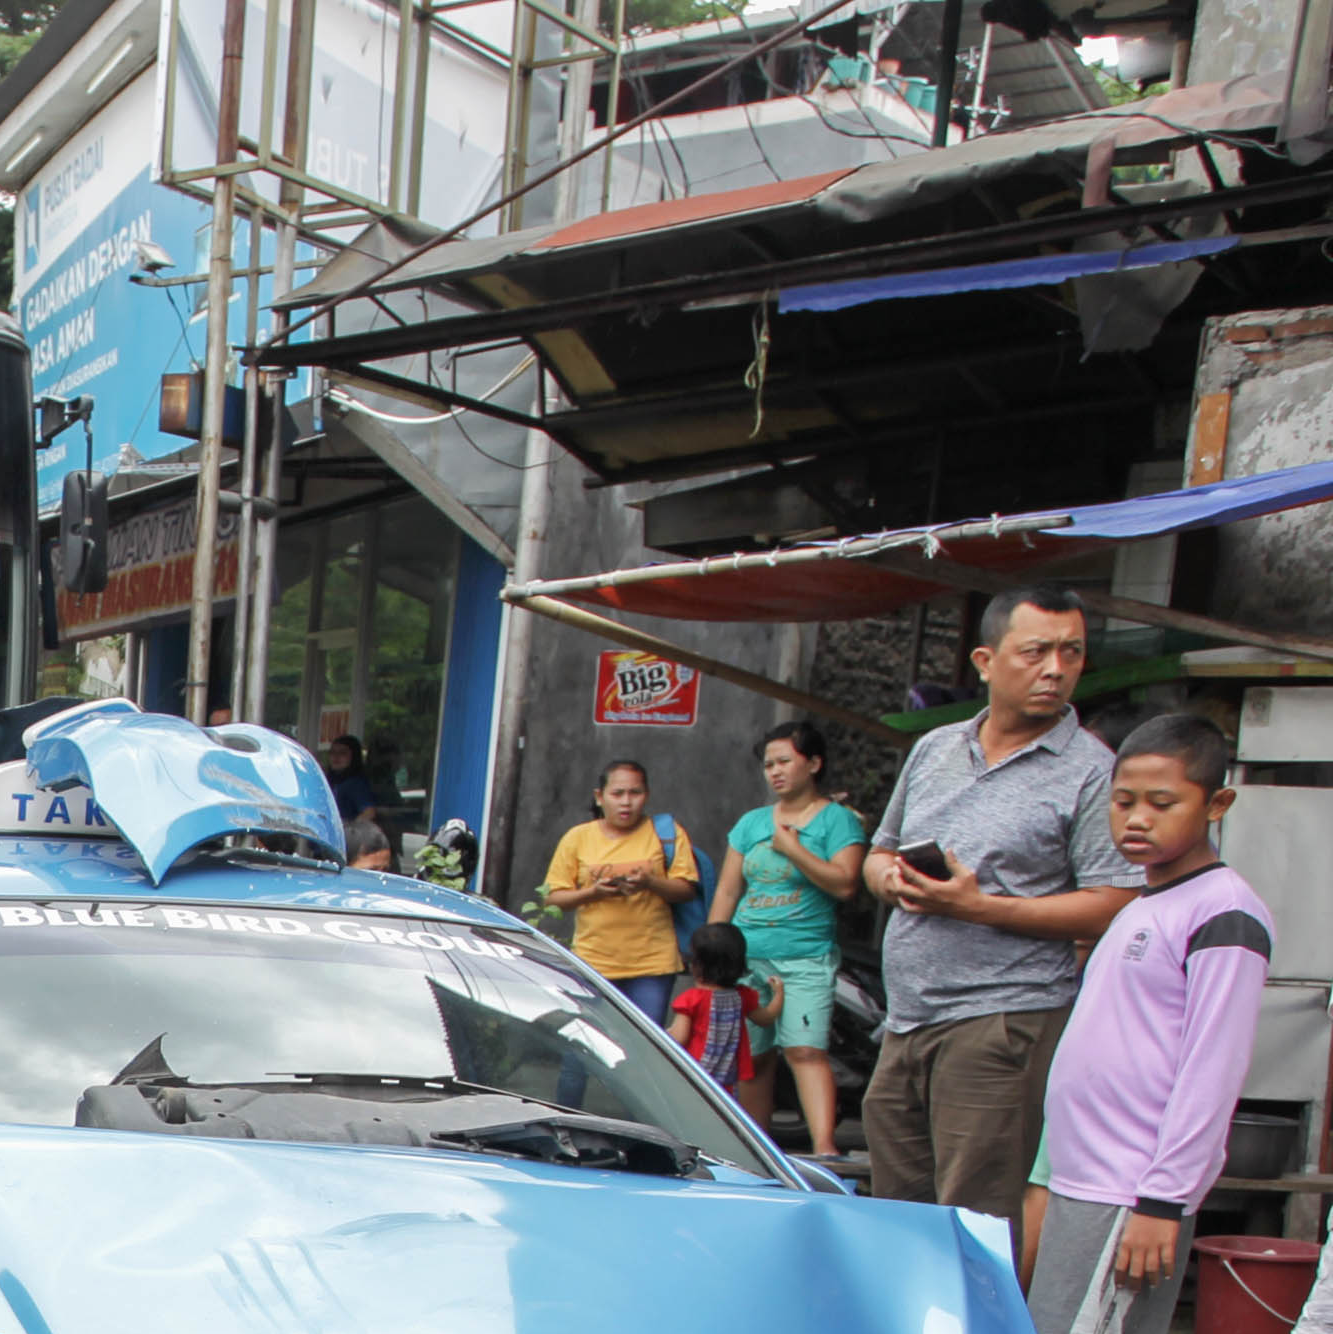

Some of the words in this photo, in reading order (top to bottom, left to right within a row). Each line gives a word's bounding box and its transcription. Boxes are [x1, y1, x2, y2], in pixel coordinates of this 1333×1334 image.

[45, 164, 73, 217] PUSAT
[26, 256, 84, 331] GADAIKAN
[88, 210, 152, 288] DENGAN
[57, 307, 95, 362] AMAN
[617, 665, 668, 696] Big
[161, 908, 312, 938] BIRD
[321, 919, 526, 961] GROUP
